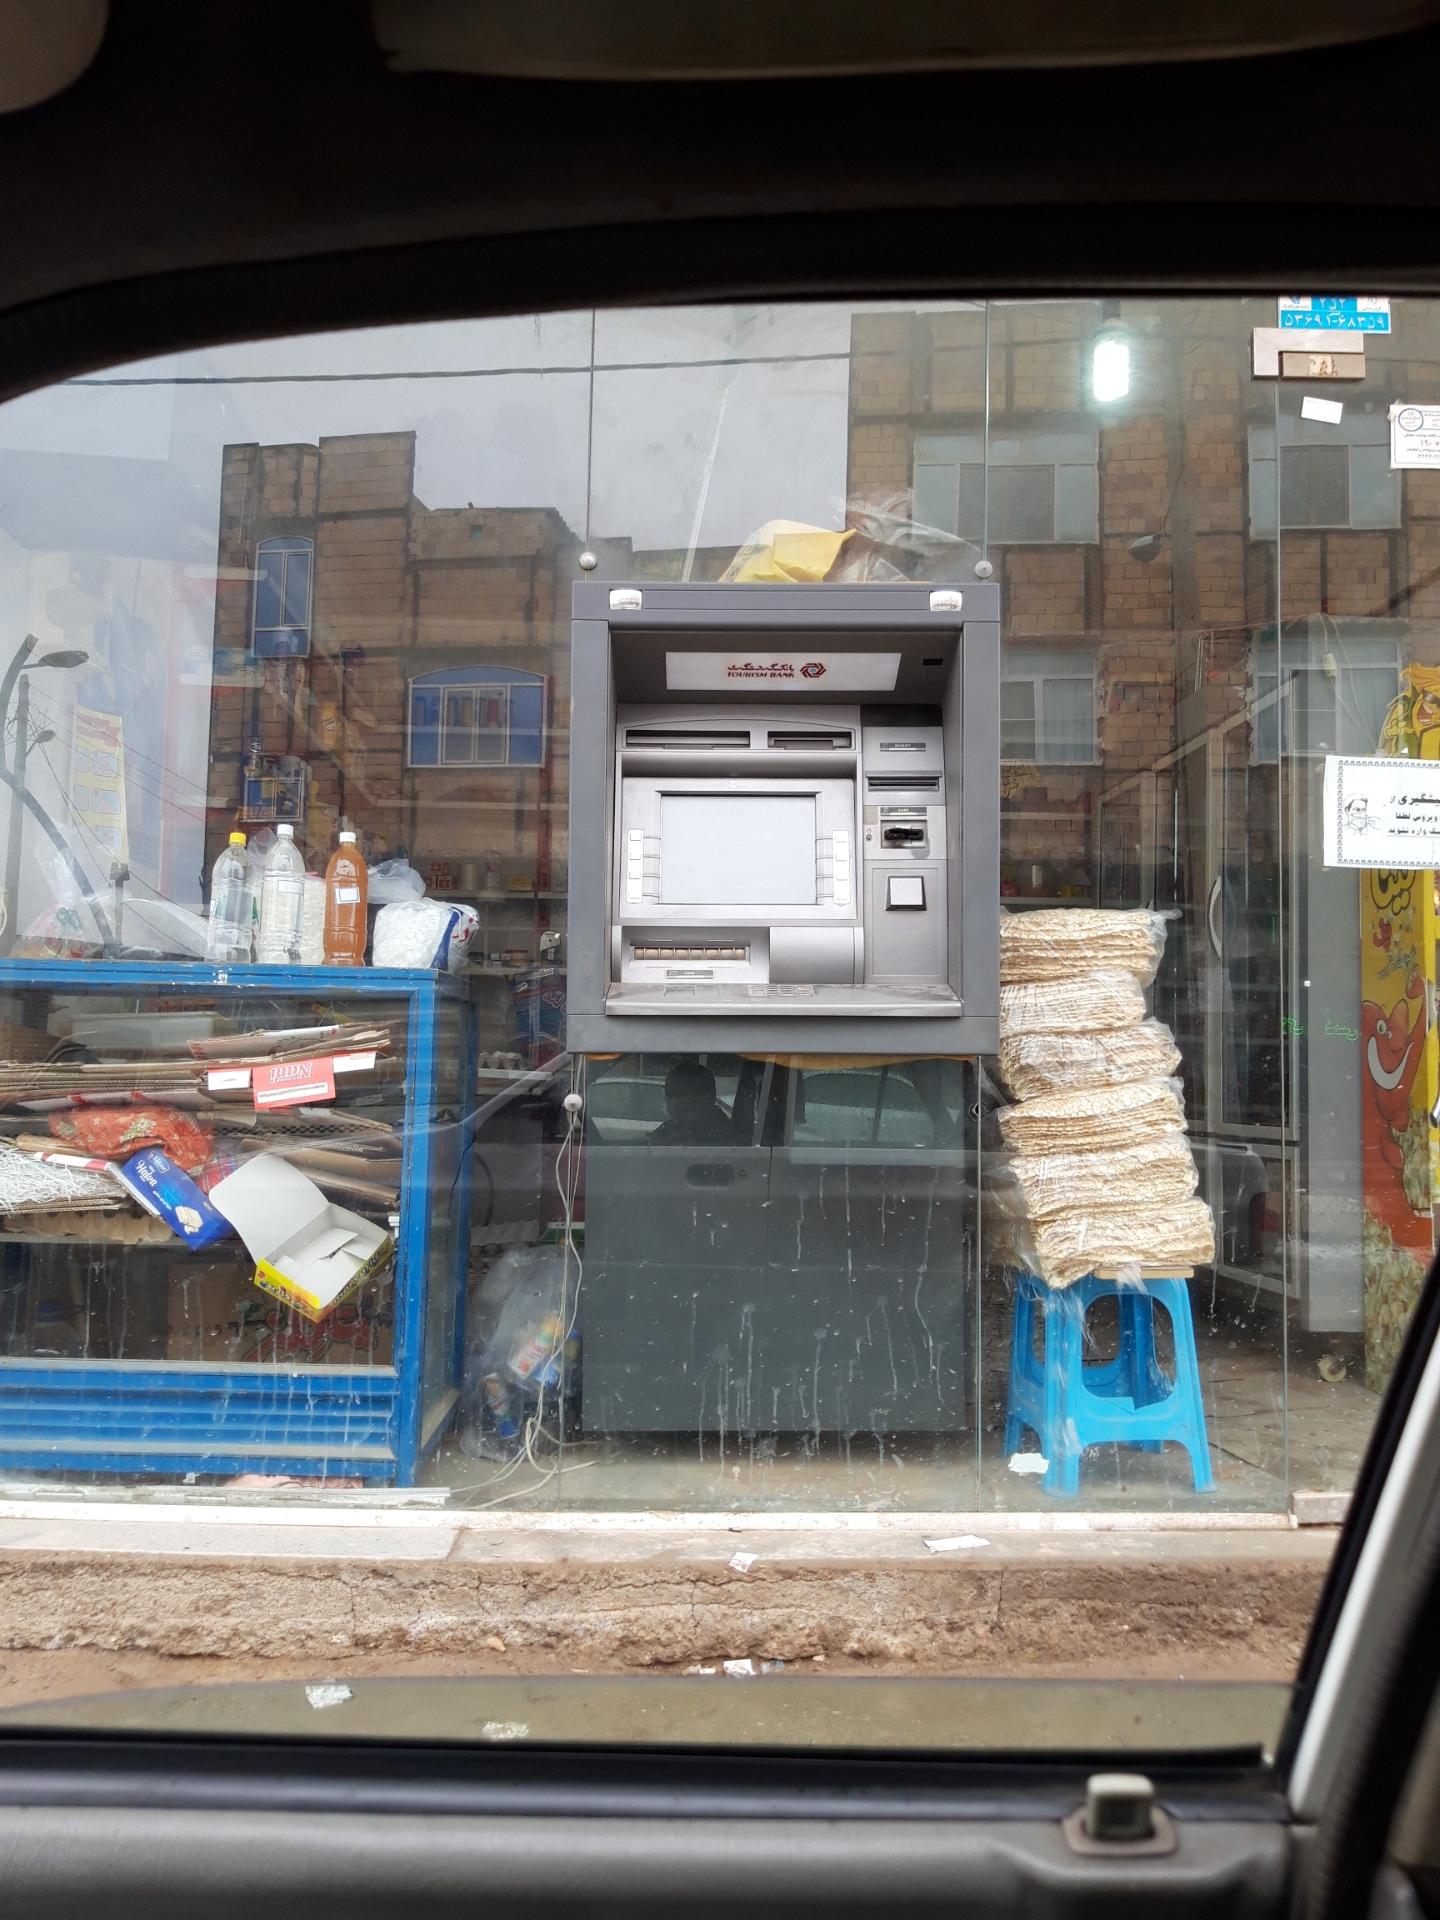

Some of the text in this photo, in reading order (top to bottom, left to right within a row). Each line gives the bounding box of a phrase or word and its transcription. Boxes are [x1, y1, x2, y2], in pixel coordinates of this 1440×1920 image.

[727, 671, 795, 679] TOURISM BANK
[1397, 792, 1440, 808] یشگیری
[1395, 811, 1411, 820] لطفا
[1388, 826, 1409, 836] نشوید
[135, 1159, 158, 1187] Halva
